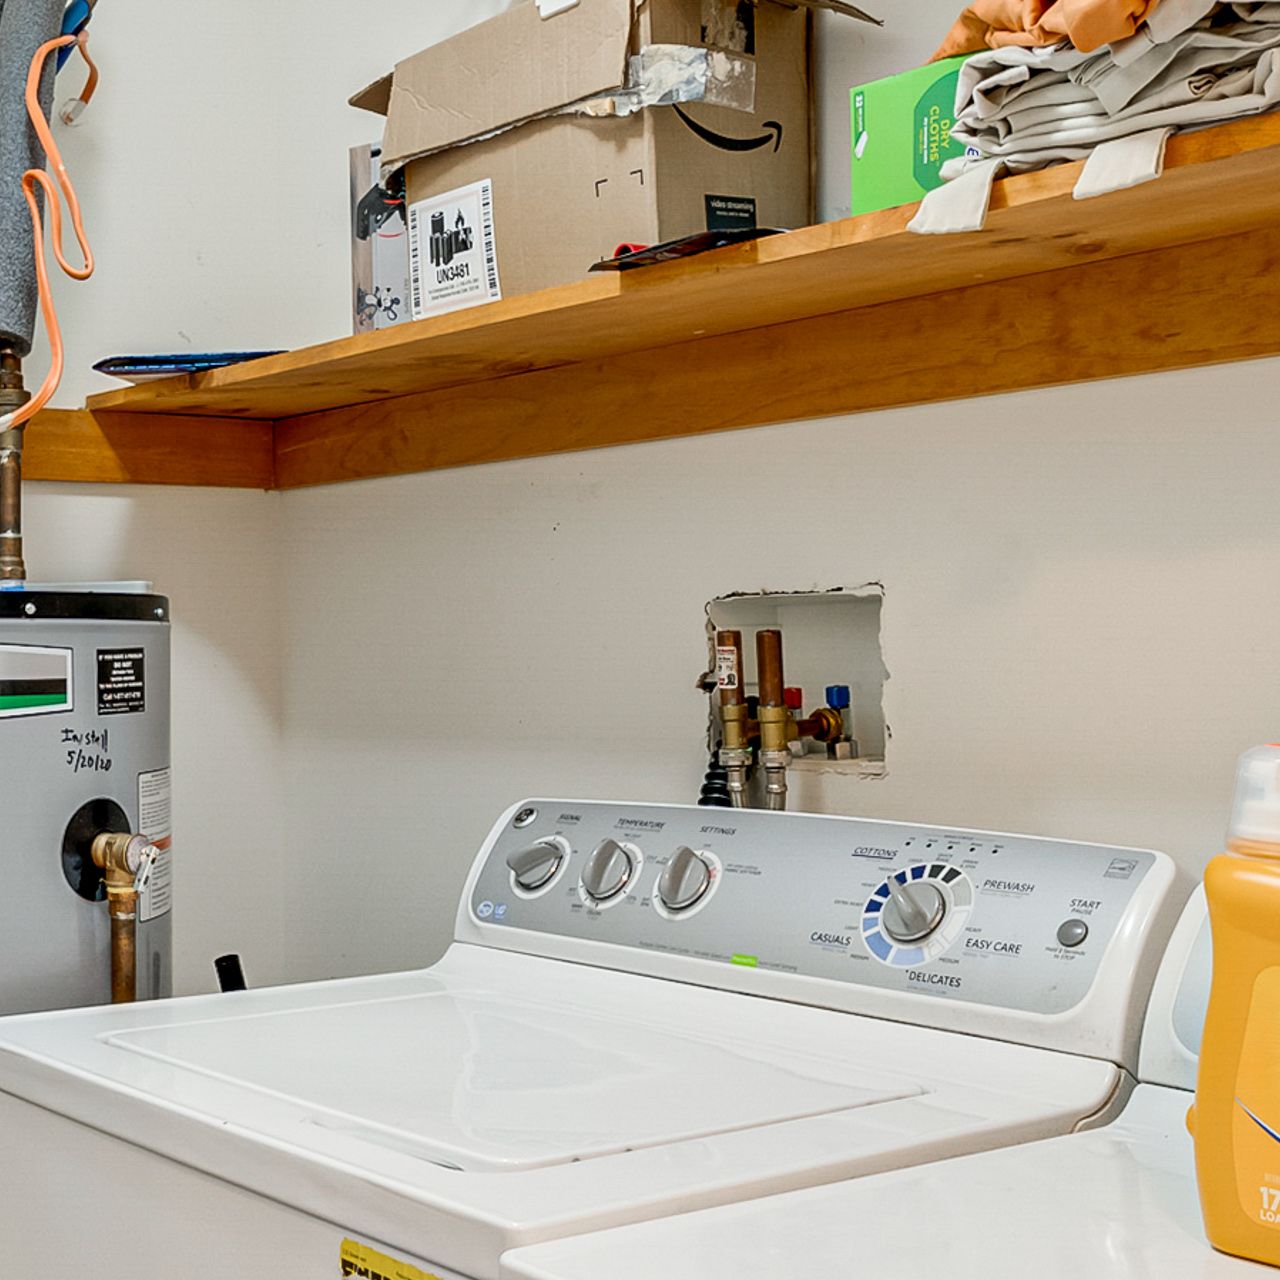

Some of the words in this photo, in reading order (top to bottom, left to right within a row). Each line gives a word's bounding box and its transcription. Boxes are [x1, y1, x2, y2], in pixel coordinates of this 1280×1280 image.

[930, 106, 940, 161] CLOTHS
[940, 119, 951, 148] DRY
[437, 263, 470, 284] UN3481
[66, 749, 112, 773] 5/20/20
[618, 818, 666, 830] TEMPERATURE
[700, 826, 737, 836] SETTINGS
[854, 846, 898, 858] COTTONS
[983, 879, 1035, 892] PREWASH
[1069, 898, 1101, 909] START
[810, 931, 851, 946] CASUALS
[965, 938, 991, 951] EASY
[993, 942, 1022, 954] CARE
[908, 970, 962, 988] DELICATES
